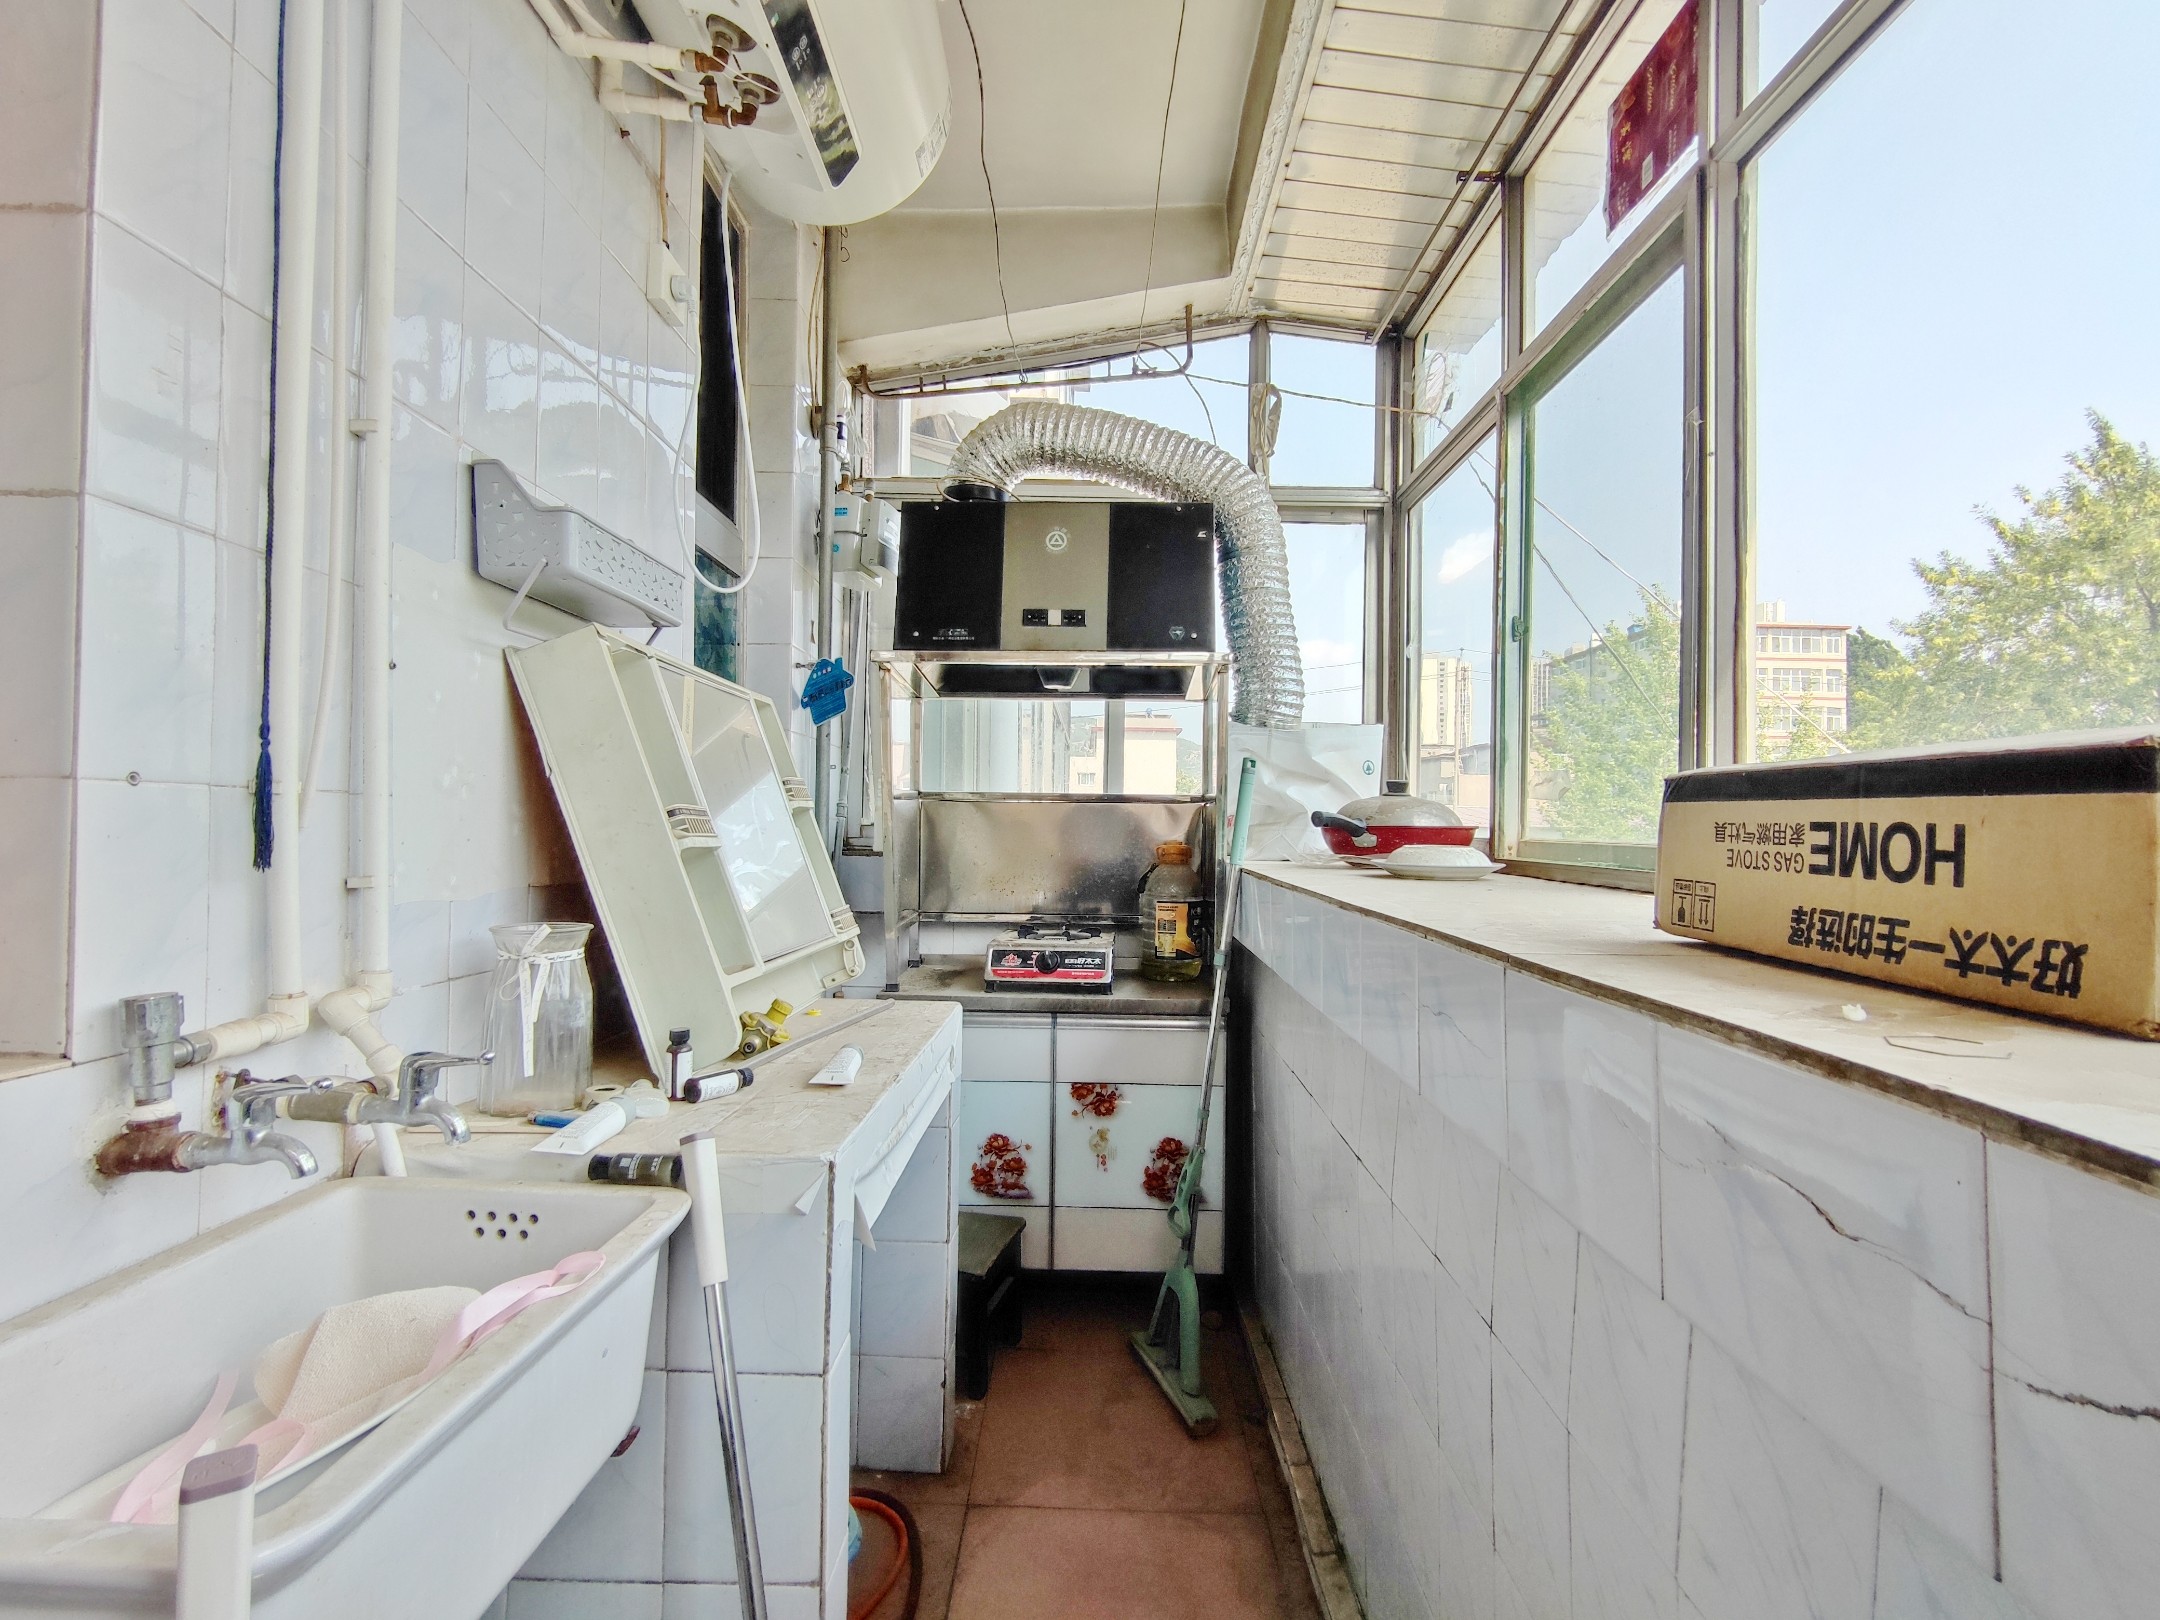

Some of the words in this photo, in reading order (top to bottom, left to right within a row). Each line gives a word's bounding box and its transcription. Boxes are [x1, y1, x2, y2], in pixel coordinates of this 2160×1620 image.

[1713, 821, 1806, 848] 家用燃气灶具
[1726, 848, 1771, 871] STOVE
[1773, 852, 1805, 874] GAS
[1808, 821, 1966, 888] HOME
[1787, 905, 2089, 999] 好太太一生的选择
